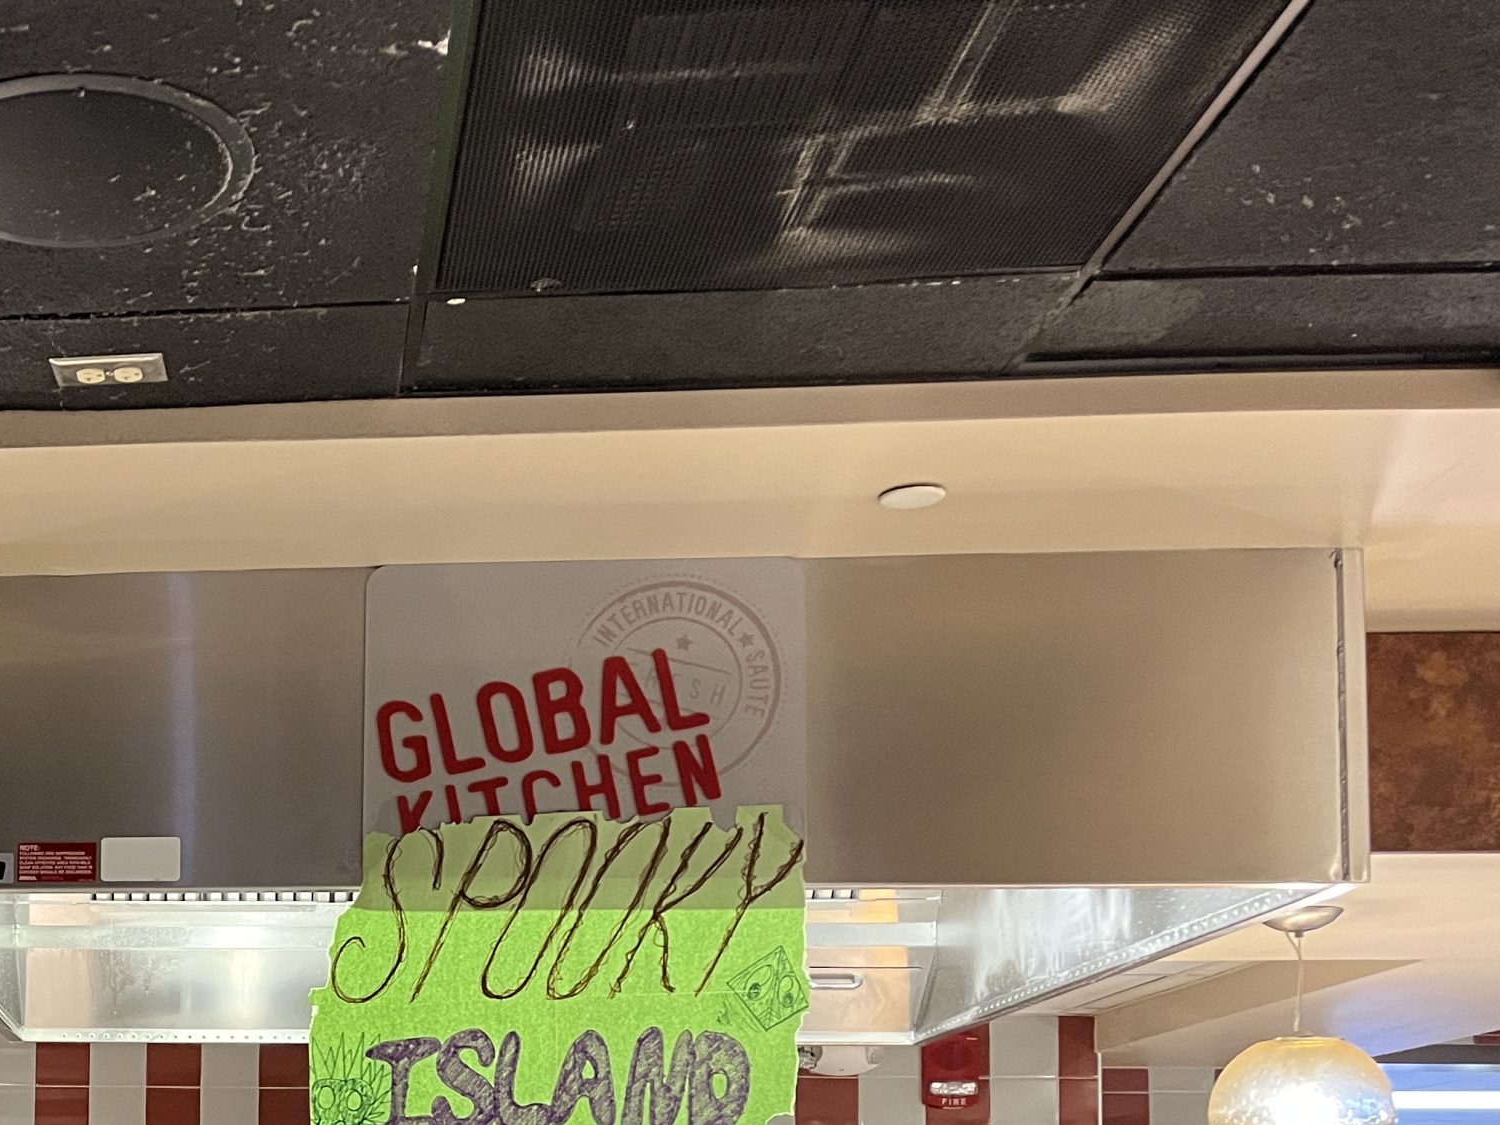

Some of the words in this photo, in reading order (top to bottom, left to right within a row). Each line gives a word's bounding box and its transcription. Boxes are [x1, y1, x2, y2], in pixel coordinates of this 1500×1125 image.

[593, 591, 746, 648] INTERNATIONAL
[376, 648, 711, 783] GLOBAL
[331, 811, 804, 1003] SPOOKY
[941, 1097, 967, 1106] FIRE
